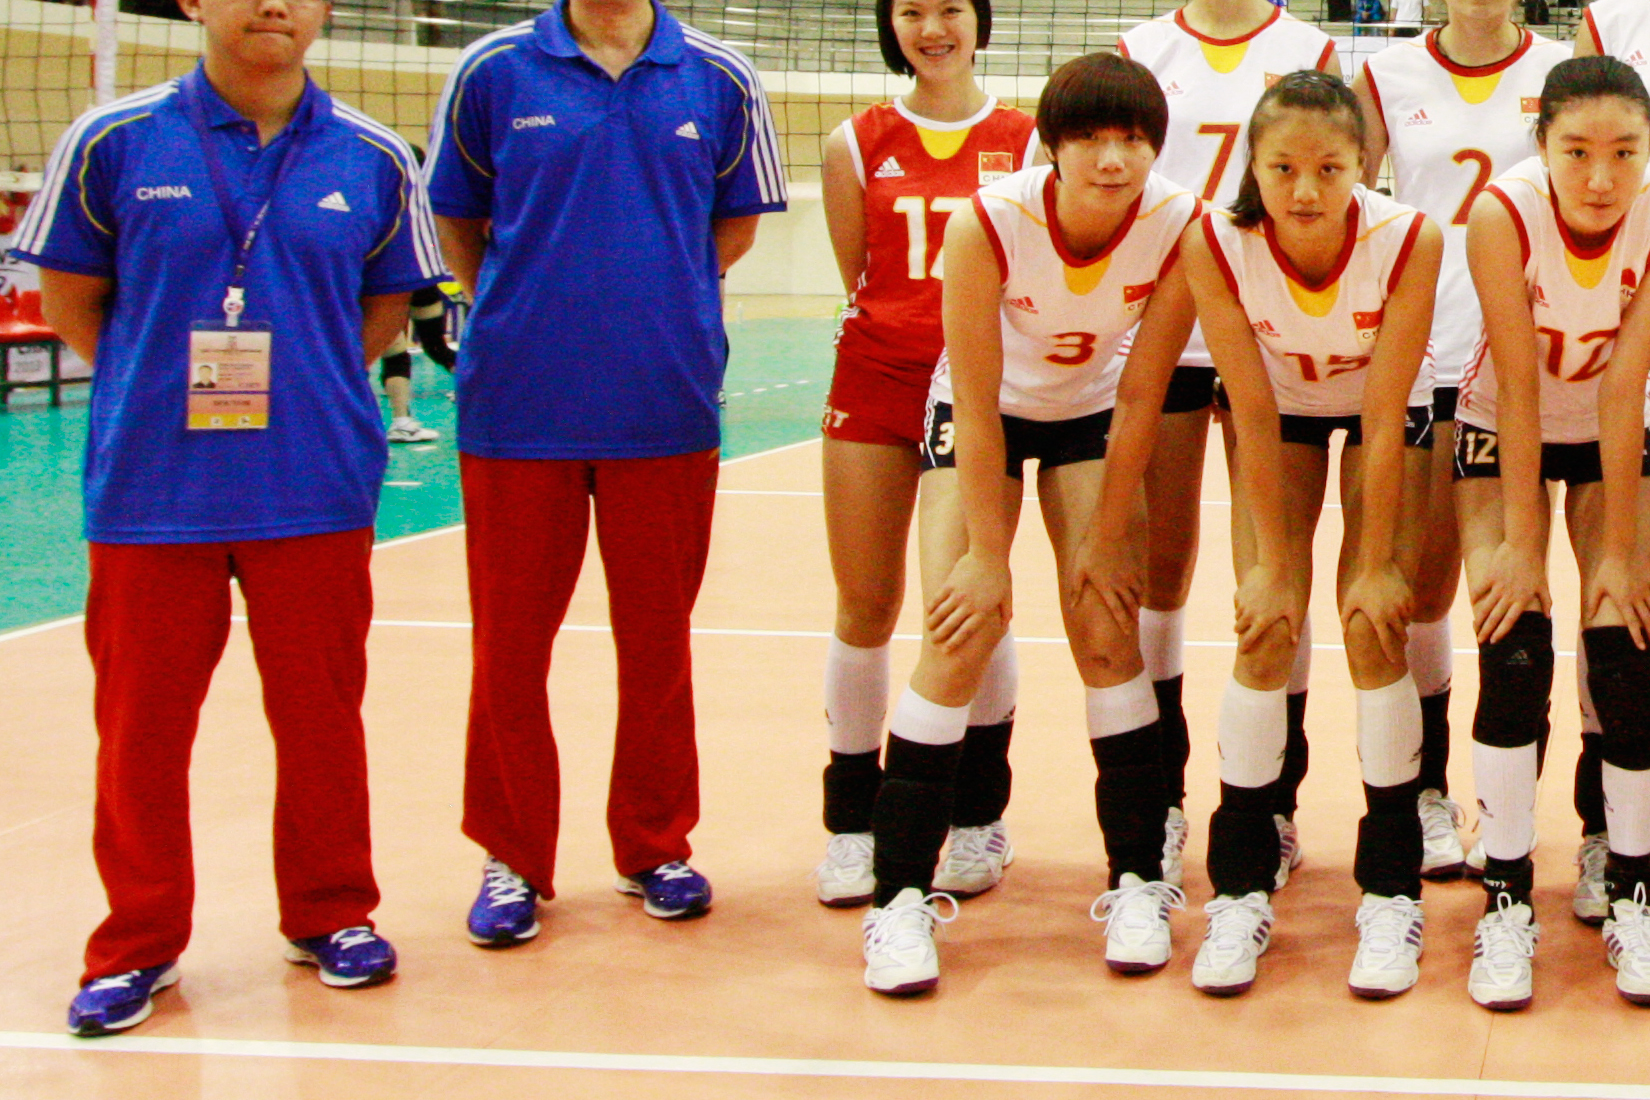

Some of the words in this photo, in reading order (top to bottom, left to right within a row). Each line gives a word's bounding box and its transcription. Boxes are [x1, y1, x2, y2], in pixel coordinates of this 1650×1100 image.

[512, 115, 556, 130] CHINA
[1197, 122, 1242, 203] 7
[136, 184, 192, 203] CHINA
[1450, 147, 1493, 227] 2
[1043, 331, 1097, 366] 3
[1537, 325, 1621, 382] 12
[1465, 431, 1498, 465] 12
